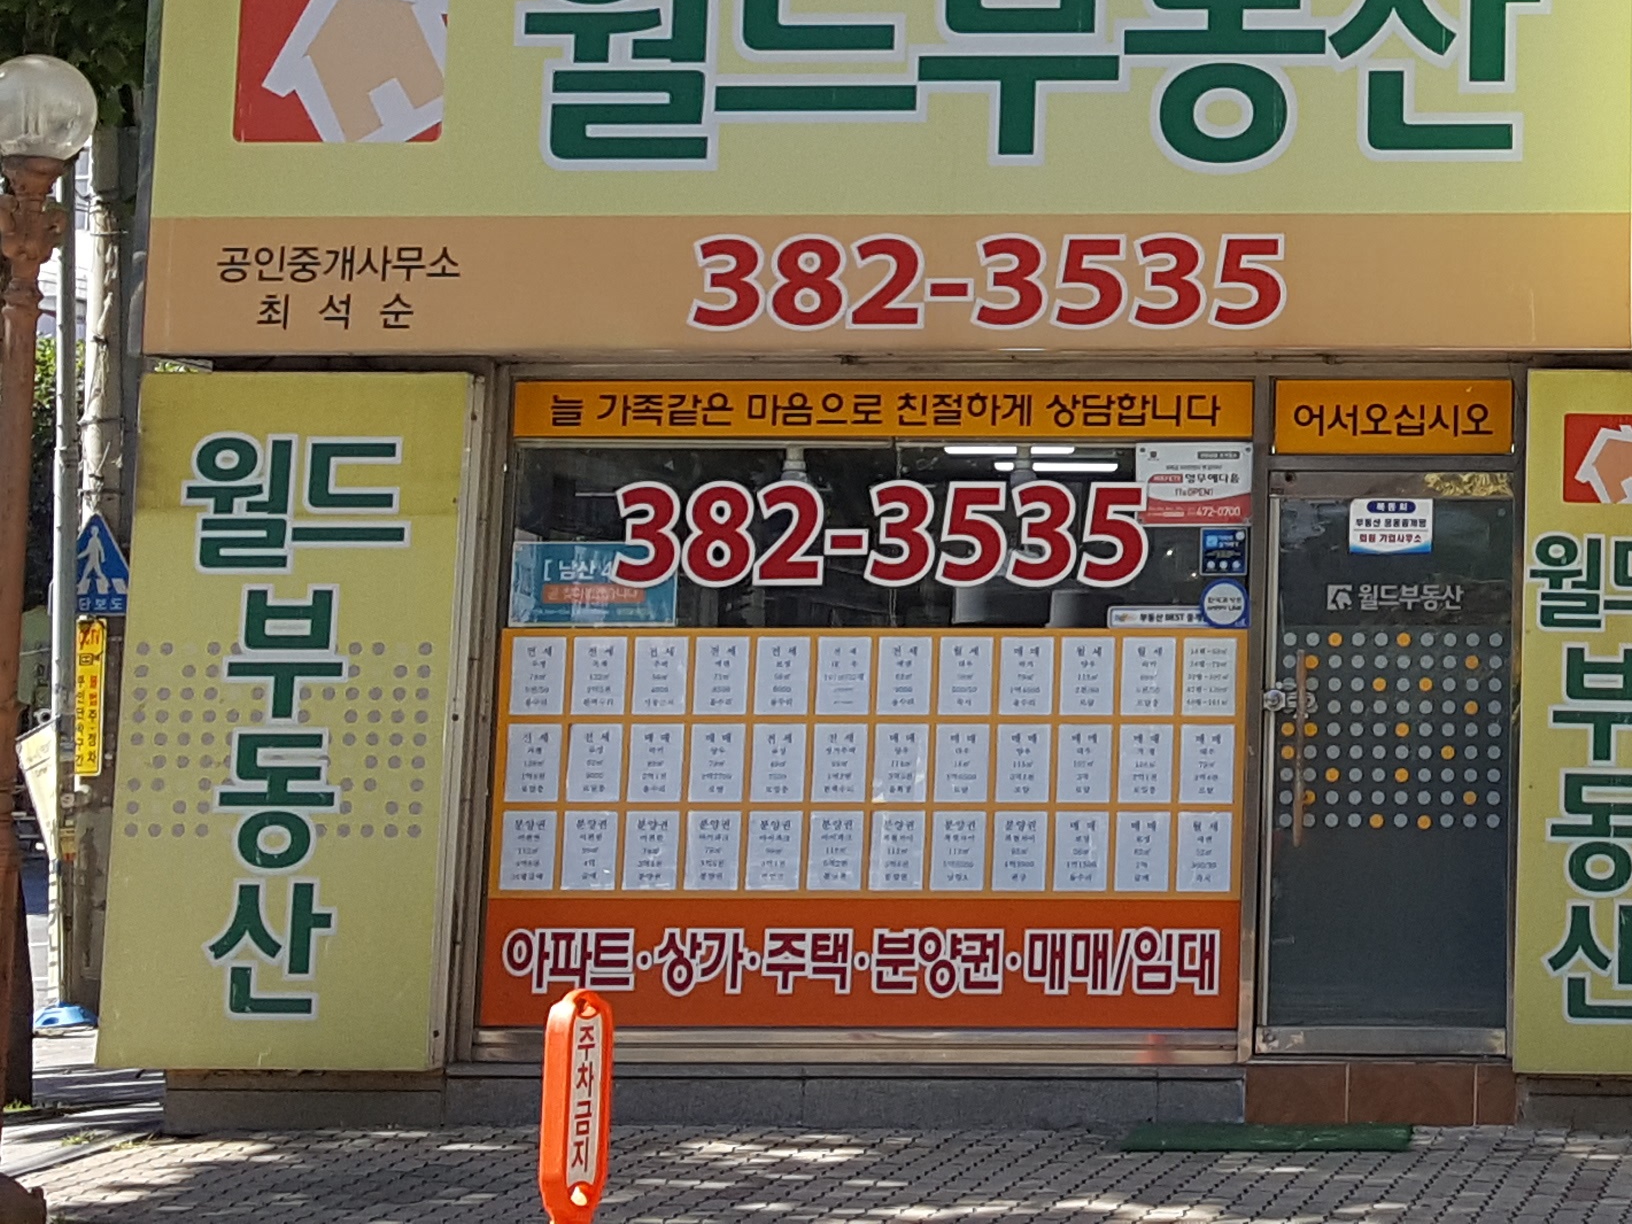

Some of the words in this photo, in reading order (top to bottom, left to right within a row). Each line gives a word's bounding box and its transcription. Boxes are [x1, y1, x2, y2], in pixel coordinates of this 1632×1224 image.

[216, 246, 462, 283] 공인중개사무소
[687, 233, 1287, 331] 382-3535
[550, 394, 584, 427] 늘
[596, 393, 735, 427] 가족같은
[747, 392, 884, 427] 마음으로
[896, 391, 1034, 428] 친절하게
[1045, 392, 1221, 428] 상담합니다
[1293, 402, 1494, 438] 어서오십시오
[614, 479, 1149, 588] 382-3535
[1358, 583, 1465, 612] 월드부동산
[570, 1026, 596, 1173] 주차금지
